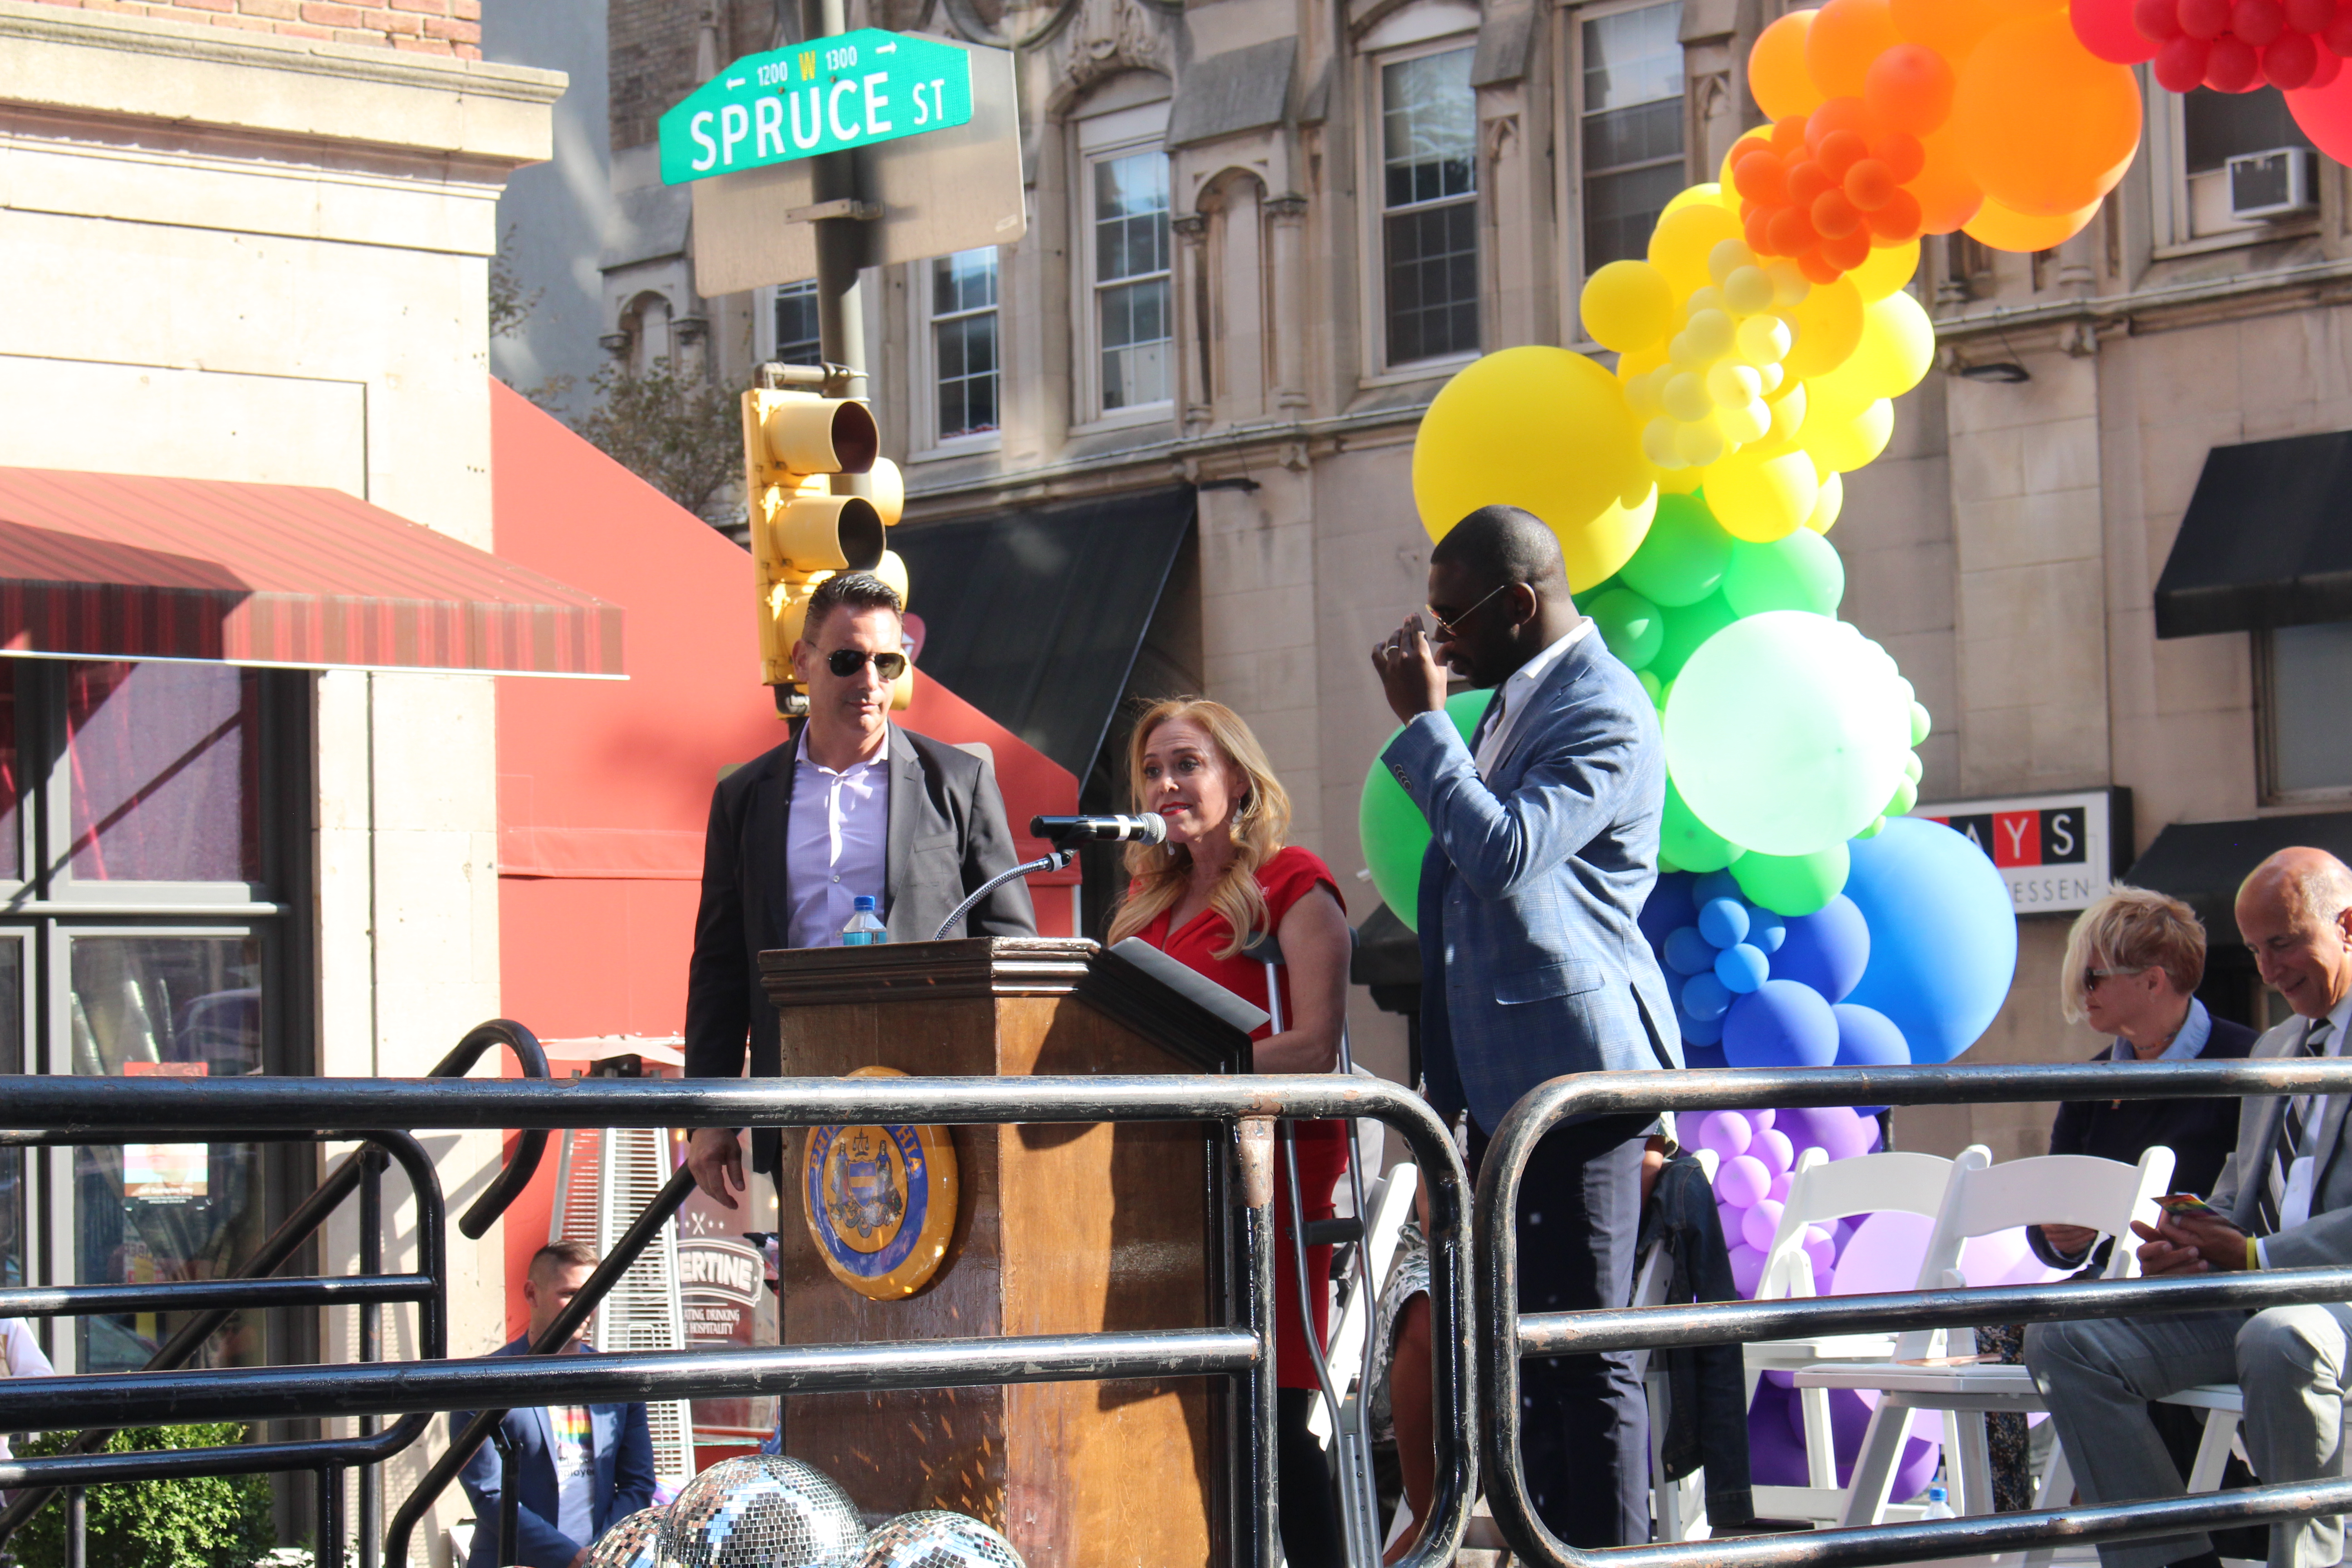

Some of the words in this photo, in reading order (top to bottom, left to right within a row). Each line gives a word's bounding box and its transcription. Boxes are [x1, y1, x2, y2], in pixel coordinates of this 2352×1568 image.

[757, 61, 788, 86] 1200
[798, 49, 816, 81] W
[825, 45, 858, 71] 1300
[690, 71, 892, 171] SPRUCE
[912, 78, 945, 125] ST
[2007, 877, 2089, 903] ESSEN
[690, 1322, 734, 1335] HOSPITALITY
[706, 1308, 740, 1325] DRINKING
